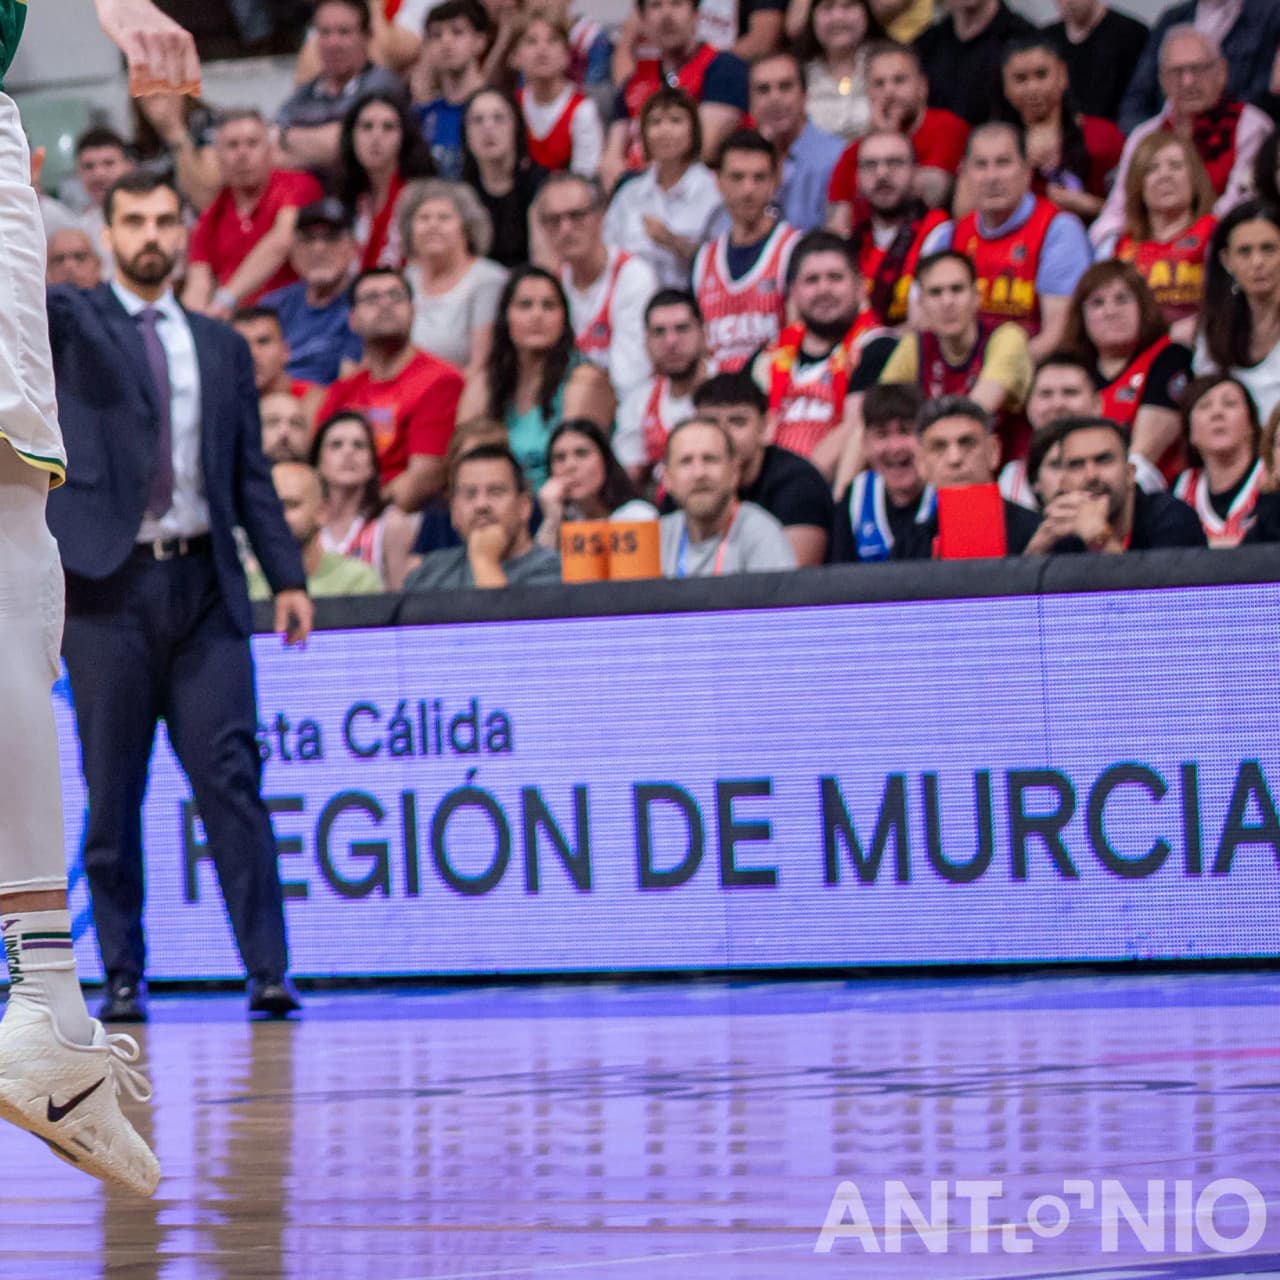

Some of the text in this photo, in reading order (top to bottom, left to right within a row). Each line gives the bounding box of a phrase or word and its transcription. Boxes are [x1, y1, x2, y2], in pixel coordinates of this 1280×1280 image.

[256, 696, 514, 761] sta Cálida
[633, 776, 779, 890] DE
[818, 756, 1280, 888] MURCIA
